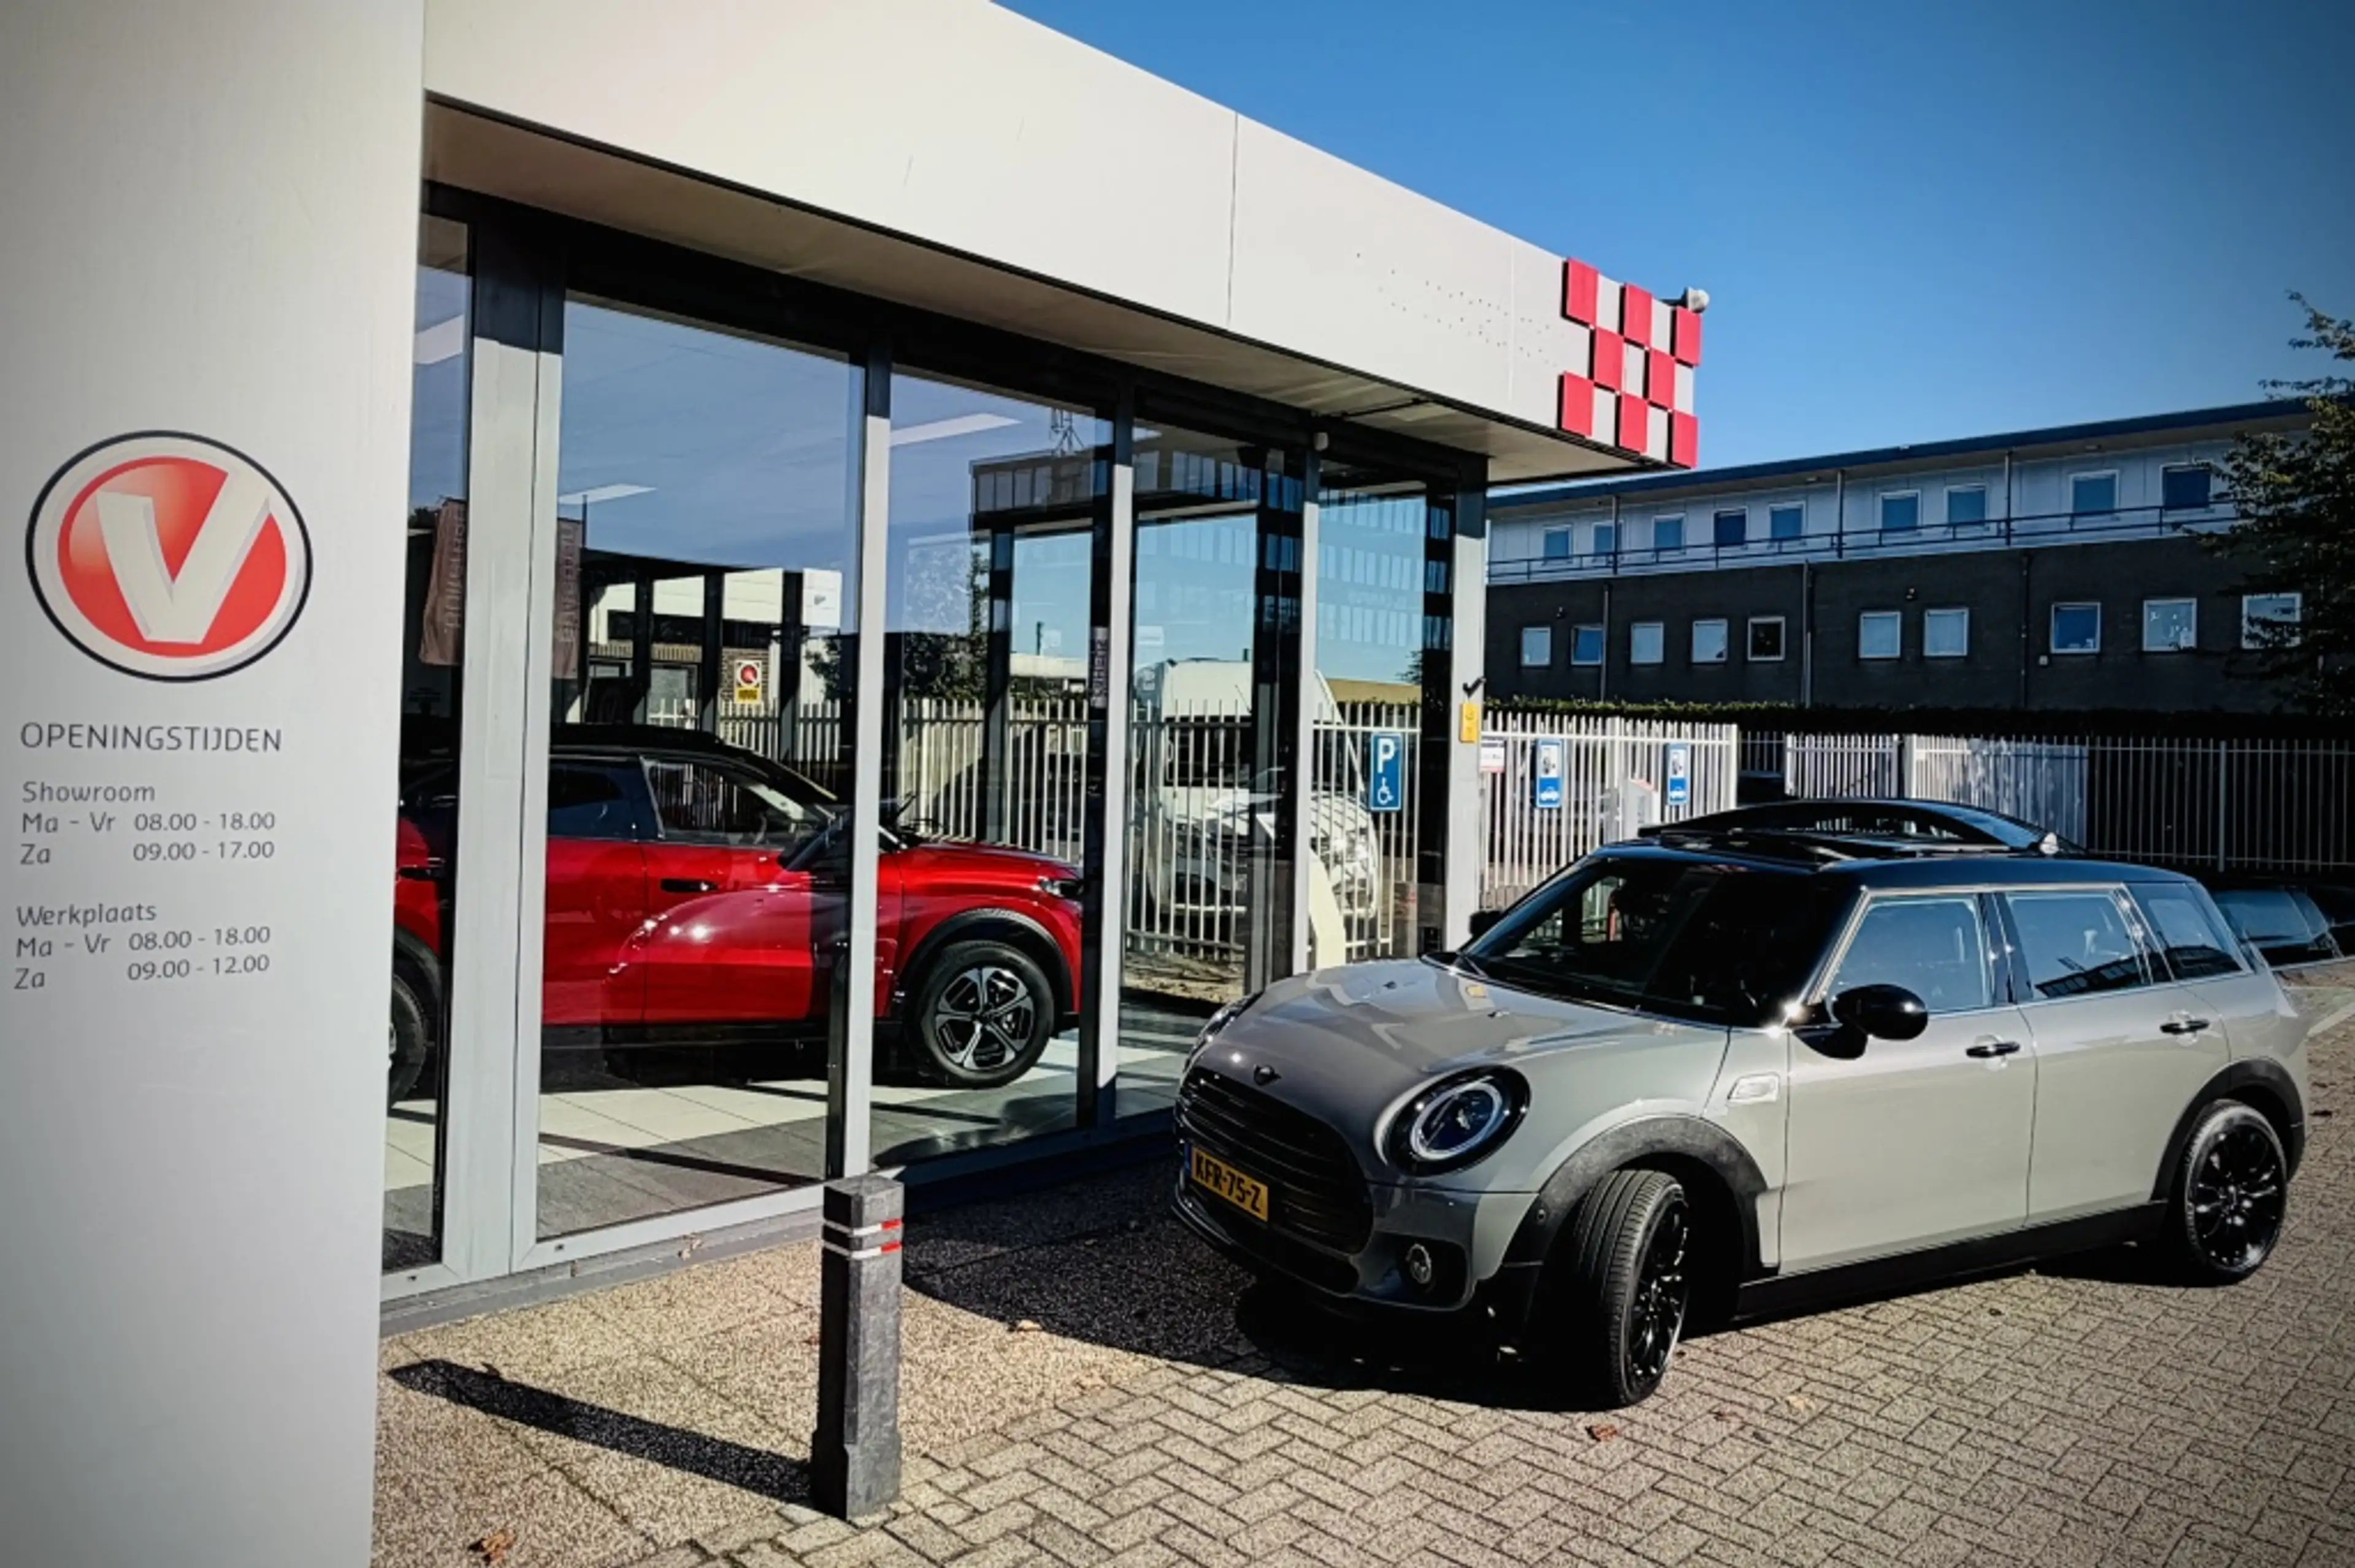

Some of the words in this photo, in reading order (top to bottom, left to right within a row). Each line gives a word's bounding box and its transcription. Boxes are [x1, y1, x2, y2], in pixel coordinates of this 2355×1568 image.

[96, 468, 271, 645] V
[20, 722, 281, 753] OPENINGSTIJDEN
[1377, 738, 1395, 773] P
[22, 781, 155, 803] Showroom
[22, 812, 59, 833] Ma
[89, 811, 116, 833] Vr
[133, 813, 197, 832] 08.00
[220, 811, 276, 831] 18.00
[20, 843, 52, 865] Za
[132, 841, 197, 862] 09.00
[218, 840, 275, 859] 17.00
[16, 903, 158, 928] Werkplaats
[15, 936, 53, 958] Ma
[84, 933, 112, 954] Vr
[128, 930, 193, 951] 08.00
[215, 925, 271, 946] 18.00
[13, 967, 45, 990] Za
[126, 958, 191, 981] 09.00
[213, 954, 270, 975] 12.00
[1196, 1152, 1262, 1214] KFR-75-Z
